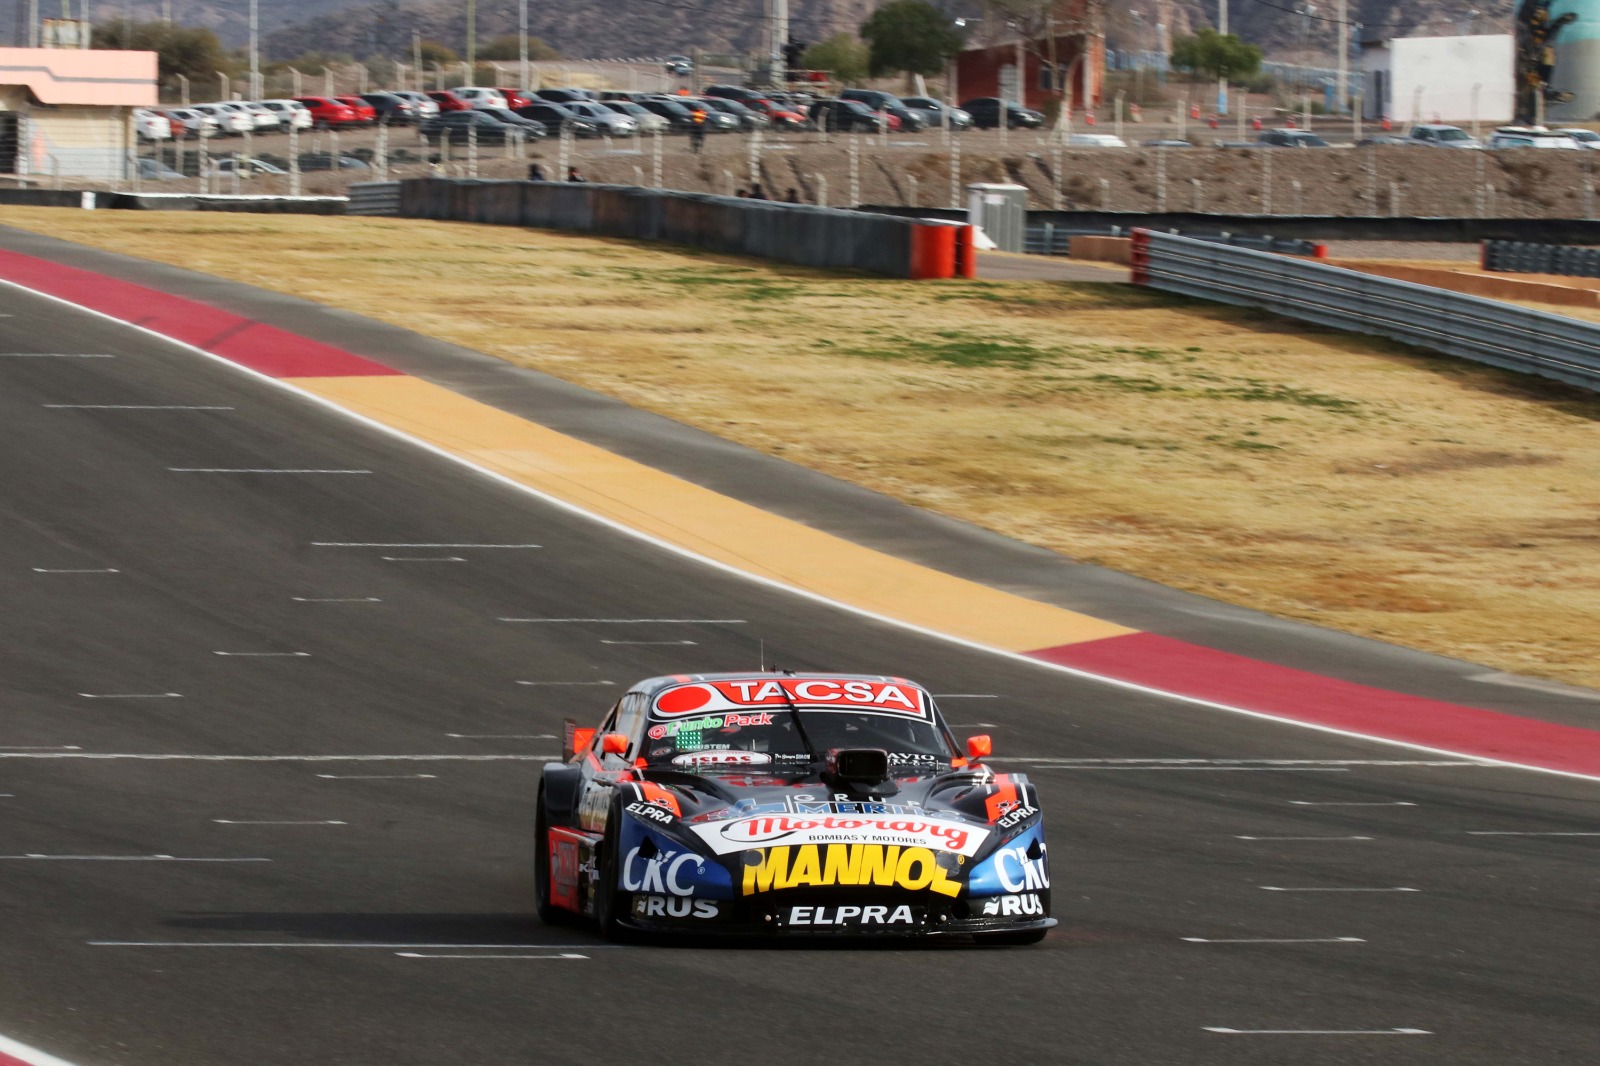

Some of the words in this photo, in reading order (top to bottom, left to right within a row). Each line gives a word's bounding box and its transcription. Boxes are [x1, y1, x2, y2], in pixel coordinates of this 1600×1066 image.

[730, 681, 916, 709] TACSA
[625, 802, 673, 824] ELPRA
[997, 805, 1038, 829] ELPRA
[741, 815, 969, 850] Motorarg
[808, 834, 858, 842] BOMBAS
[861, 834, 869, 842] Y
[871, 835, 927, 845] MOTORES
[742, 843, 963, 899] MANNOL
[647, 896, 719, 918] RUS
[788, 904, 914, 925] ELPRA
